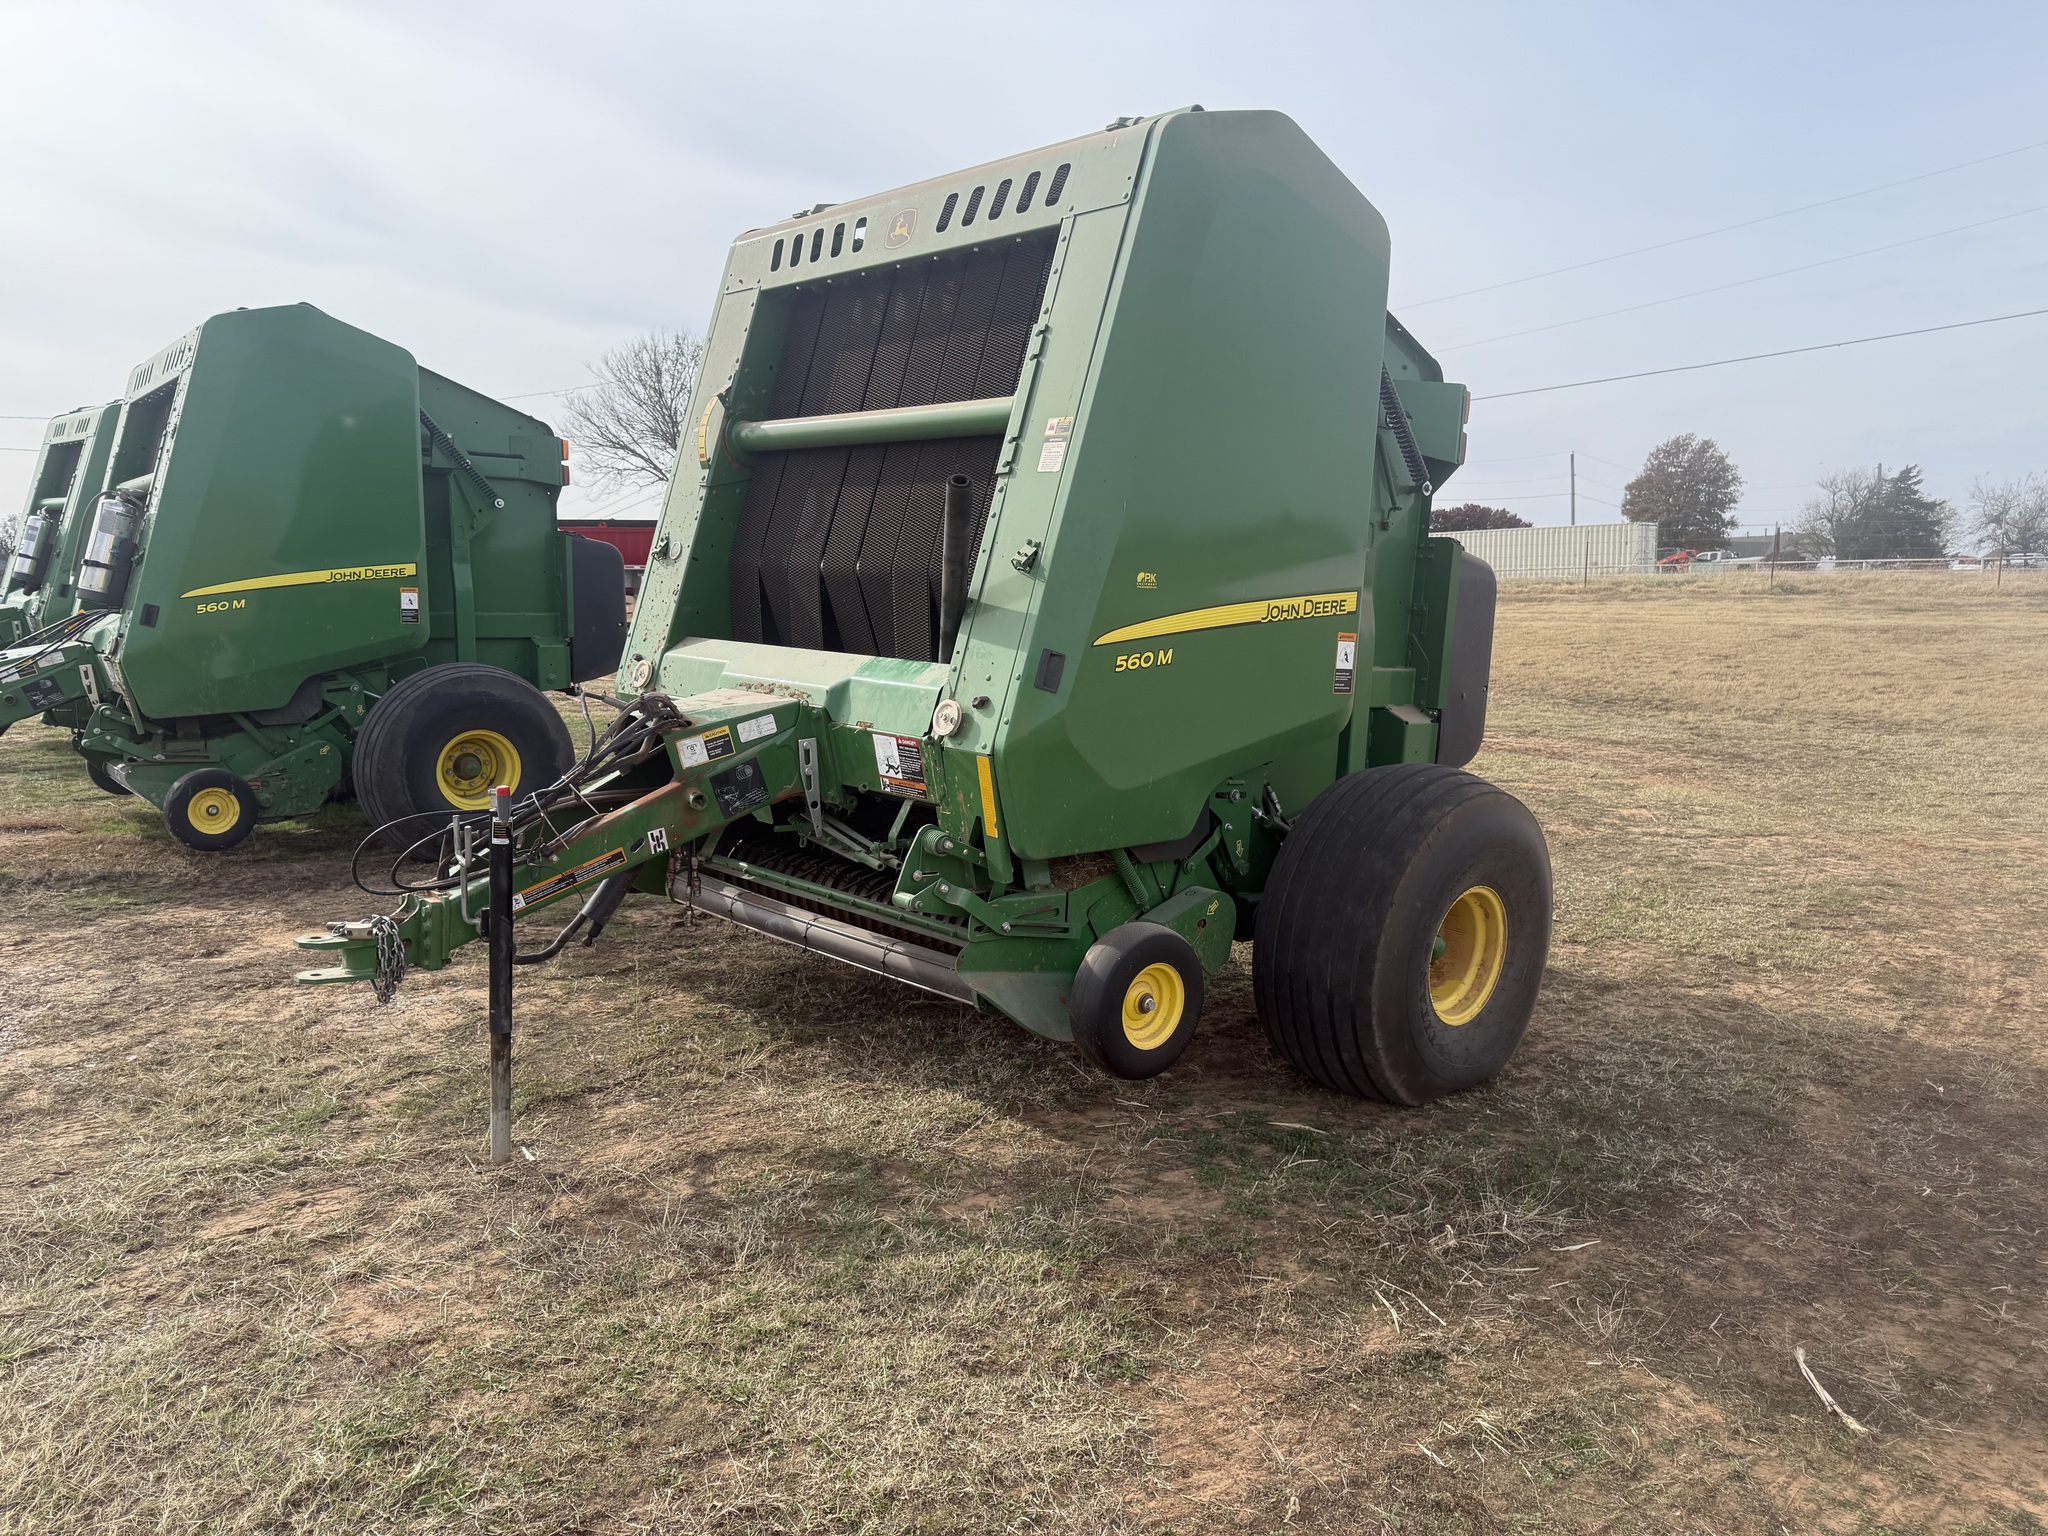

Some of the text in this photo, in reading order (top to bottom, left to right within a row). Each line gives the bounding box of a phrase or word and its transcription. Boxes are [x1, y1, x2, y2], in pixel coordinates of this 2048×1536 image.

[326, 567, 407, 582] JOHN DEERE
[196, 598, 246, 614] 560 M
[1261, 599, 1347, 621] JOHN DEERE
[1115, 648, 1174, 672] 560 M
